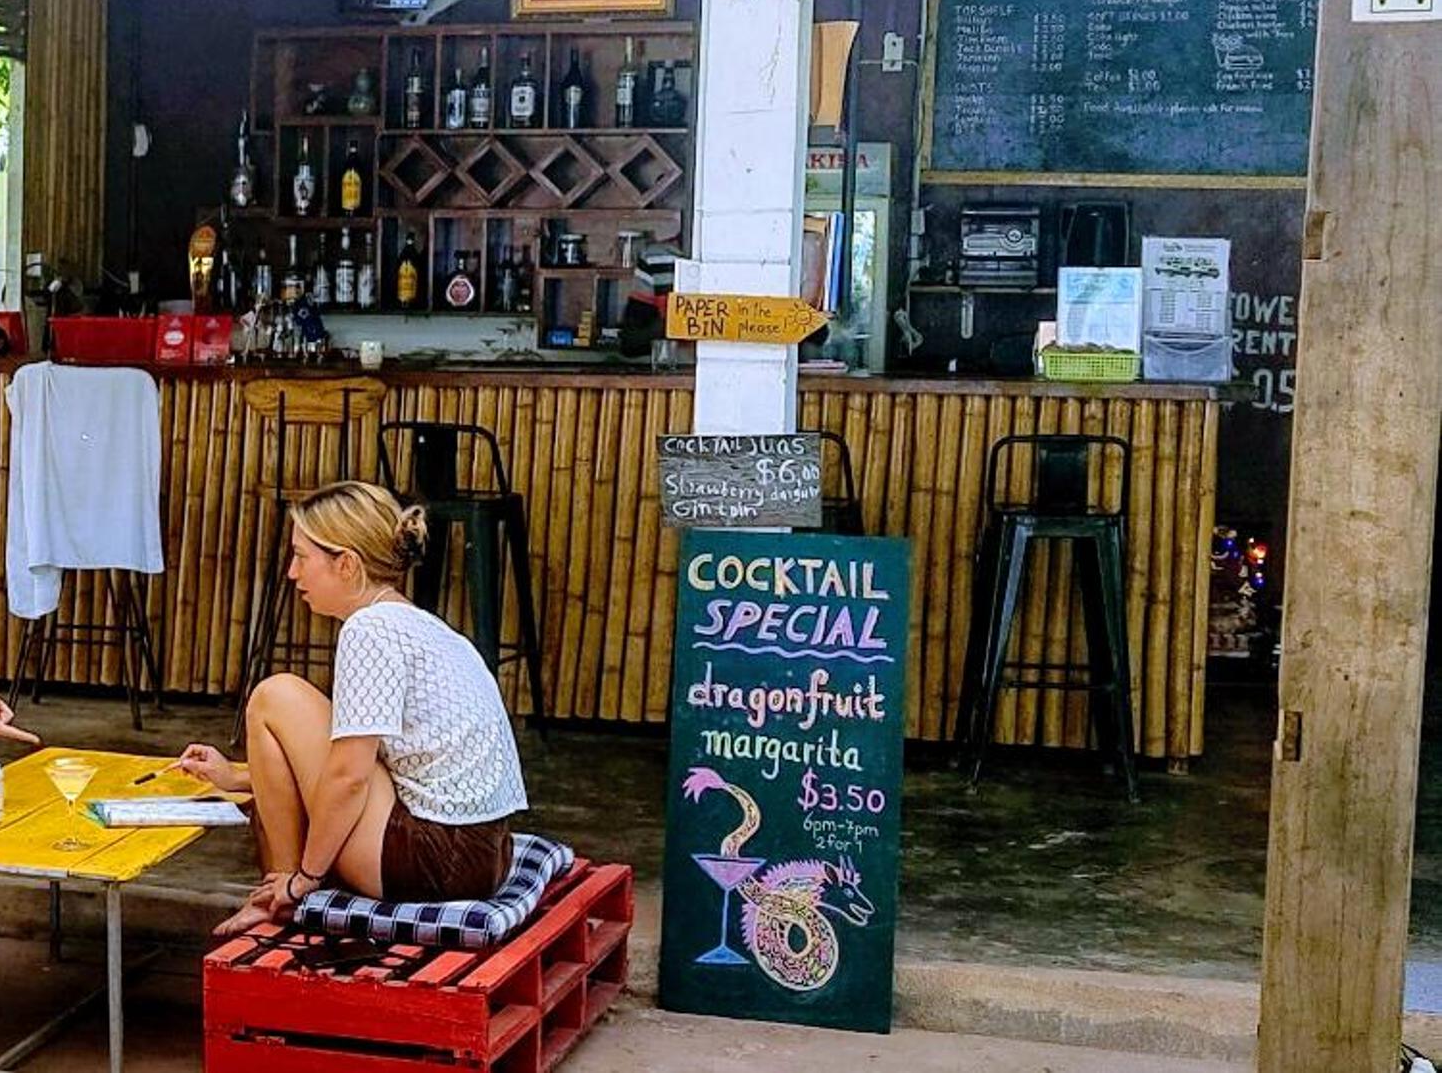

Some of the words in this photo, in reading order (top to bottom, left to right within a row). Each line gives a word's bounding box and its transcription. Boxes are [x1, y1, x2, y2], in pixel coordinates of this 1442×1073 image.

[676, 295, 729, 318] PAPER
[687, 317, 724, 335] BIN
[1231, 292, 1295, 326] OWE
[664, 474, 765, 506] Strawberry
[687, 553, 890, 601] COCKTAIL
[693, 599, 888, 649] SPECIAL
[686, 661, 886, 730] dragonfruit
[700, 728, 864, 780] margarita
[797, 766, 885, 814] $3.50
